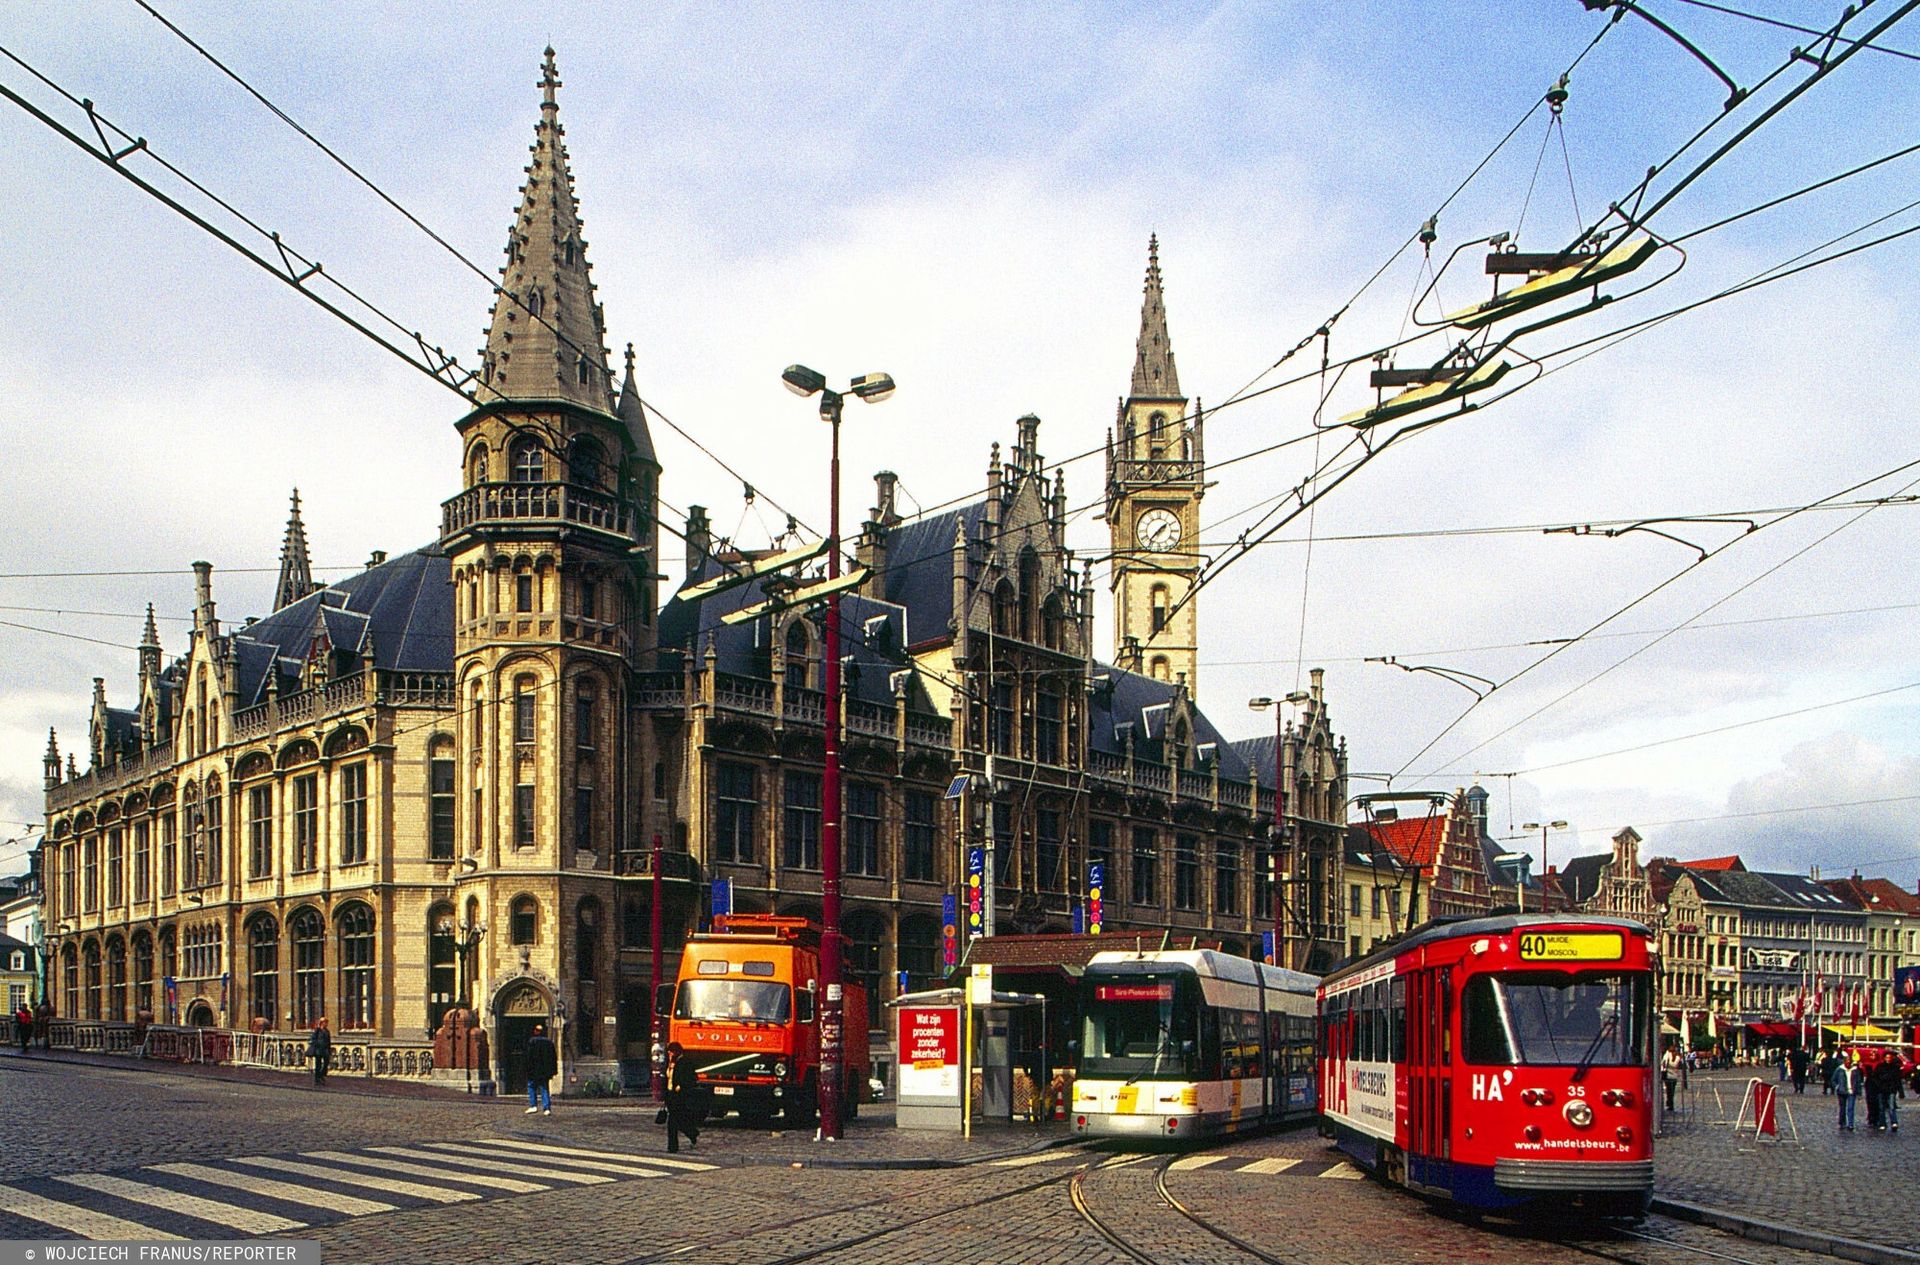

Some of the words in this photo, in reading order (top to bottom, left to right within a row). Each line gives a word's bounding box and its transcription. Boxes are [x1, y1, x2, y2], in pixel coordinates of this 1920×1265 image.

[1521, 936, 1545, 956] 40
[1100, 987, 1106, 999] 1
[916, 1014, 928, 1024] Wat
[930, 1013, 941, 1026] zijn
[696, 1032, 762, 1042] VOLVO
[912, 1027, 944, 1038] procenten
[917, 1037, 939, 1047] zonder
[911, 1048, 945, 1059] zekerheid?
[1472, 1069, 1513, 1101] HA'
[1567, 1086, 1586, 1096] 35
[1514, 1138, 1630, 1153] www.handelsbeurs.be
